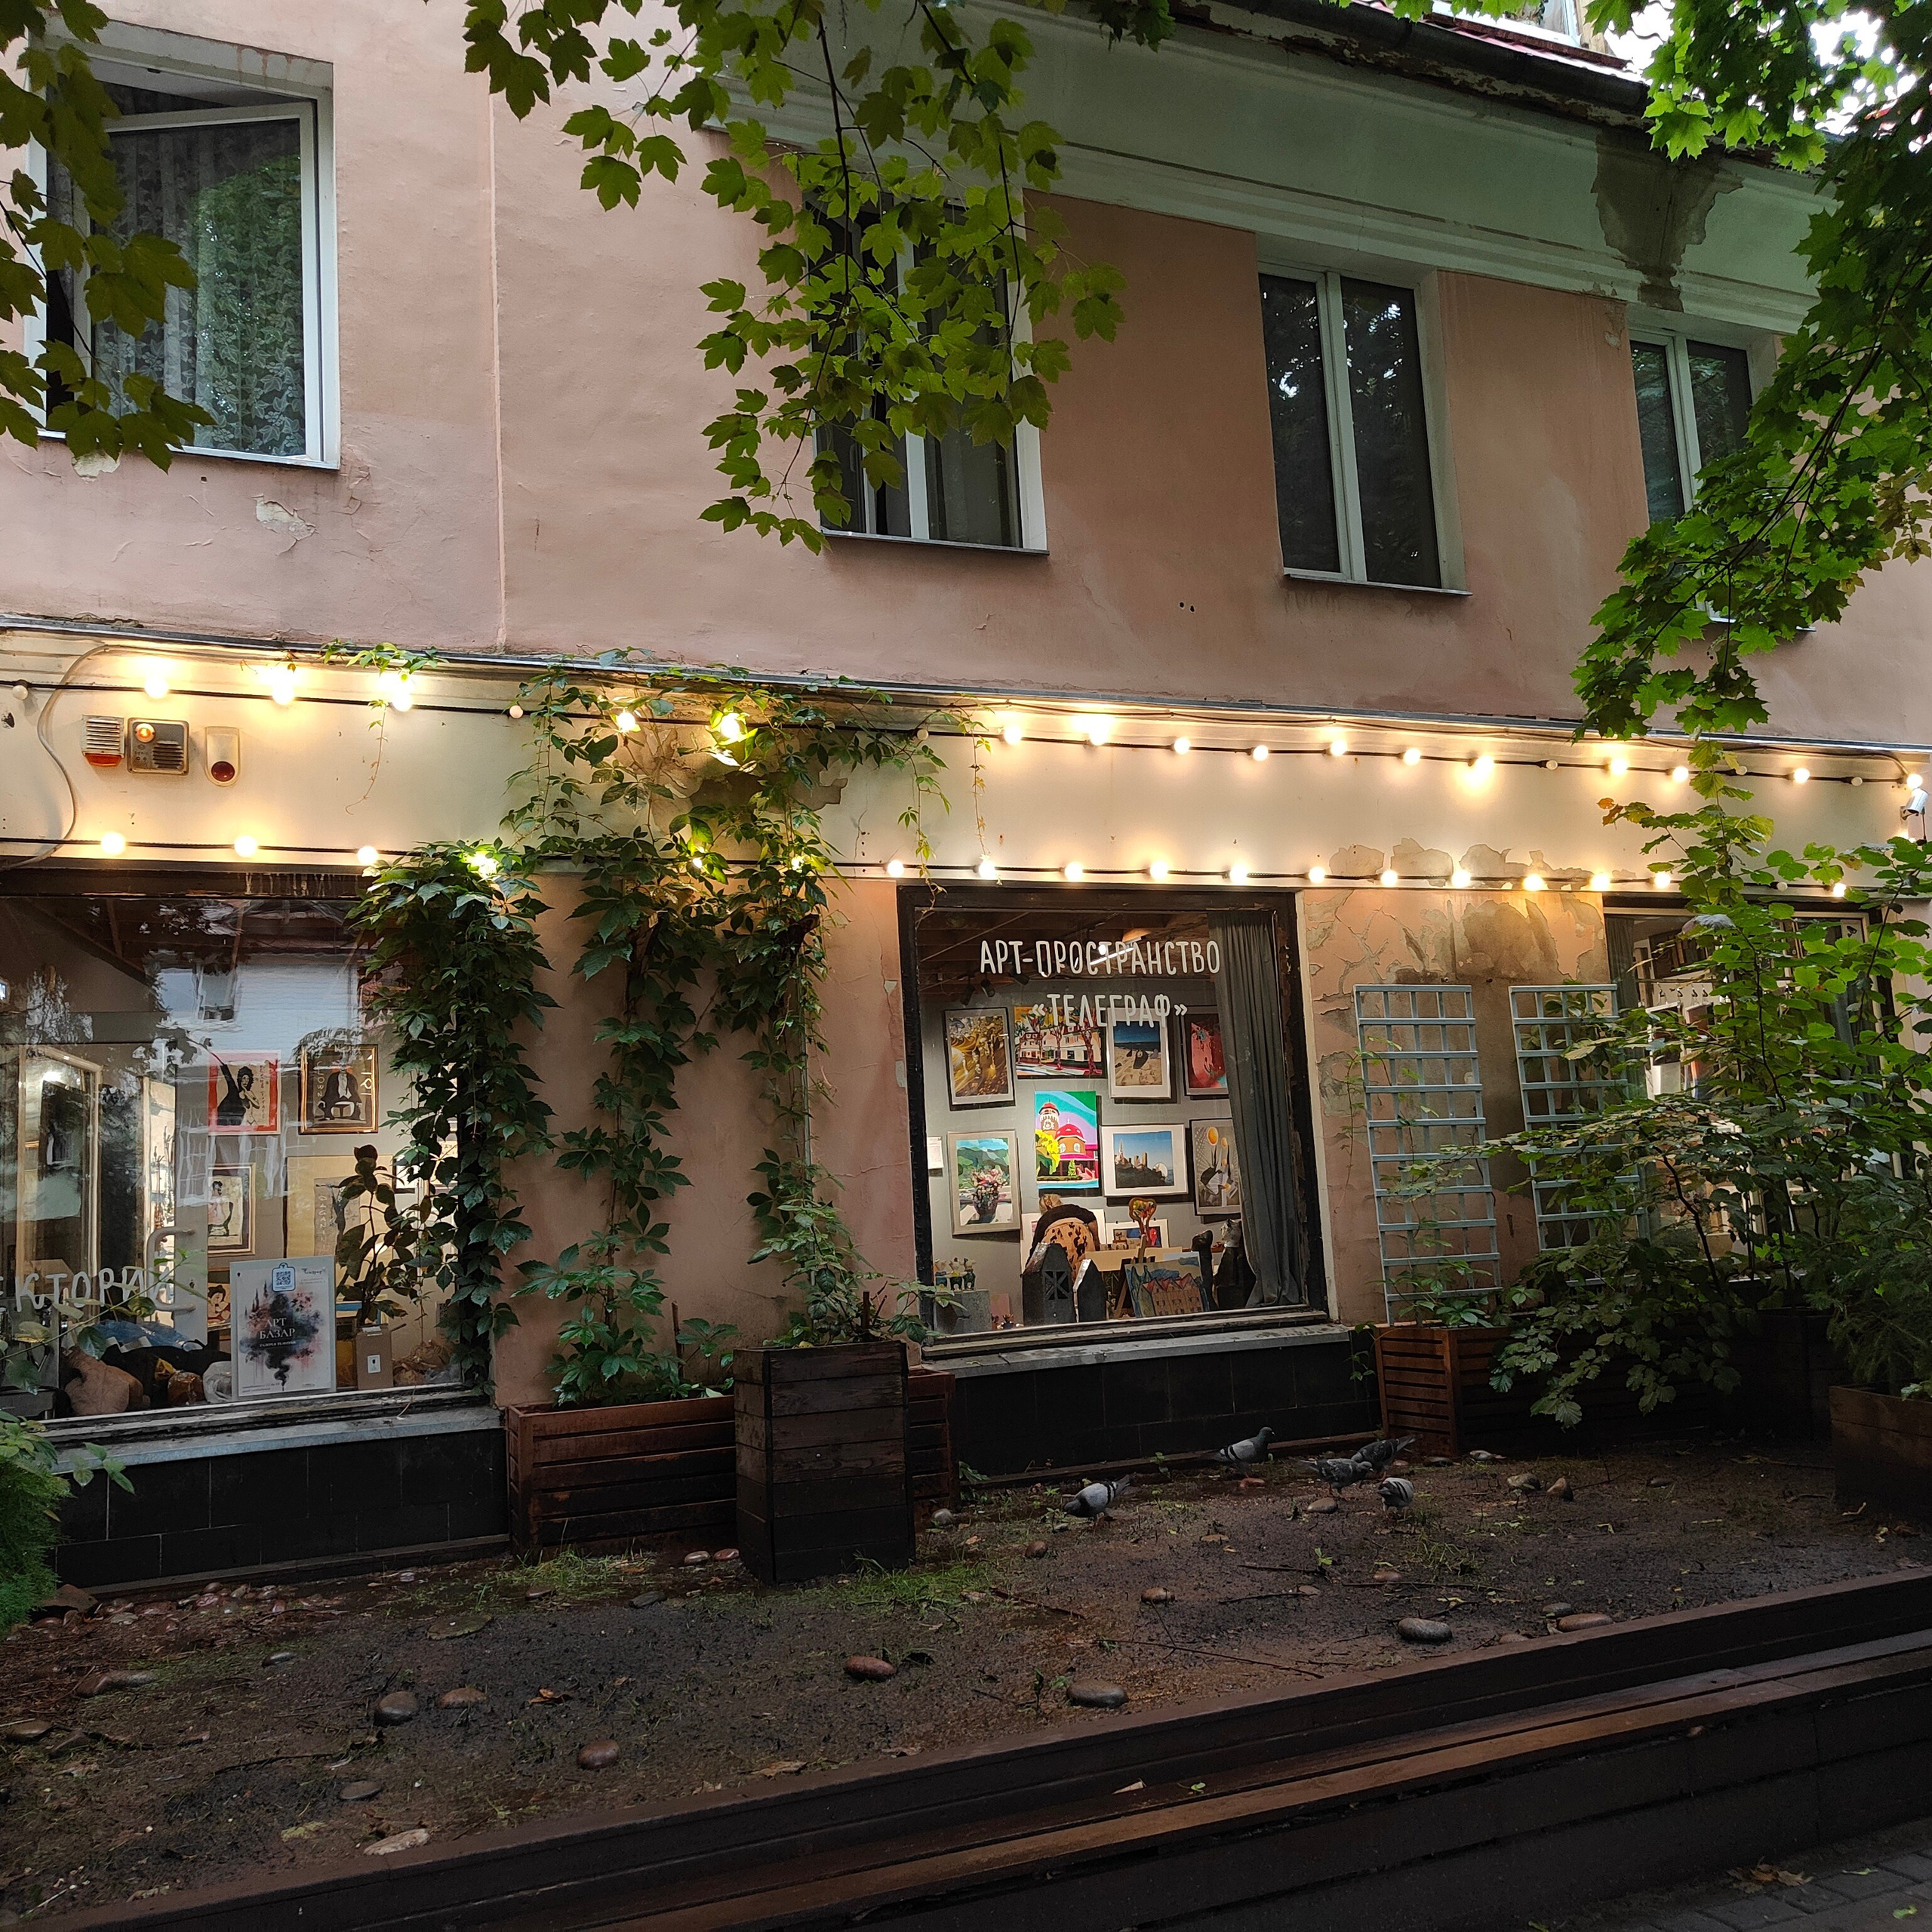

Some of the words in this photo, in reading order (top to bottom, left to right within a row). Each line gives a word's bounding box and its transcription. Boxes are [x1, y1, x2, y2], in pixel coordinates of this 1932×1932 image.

[980, 940, 1220, 975] АРТ-ПРОСТРАНСТВО
[1028, 994, 1188, 1029] «ТЕЛЕГРАФ»
[260, 1328, 296, 1340] БАЗАР
[264, 1317, 288, 1328] АРТ
